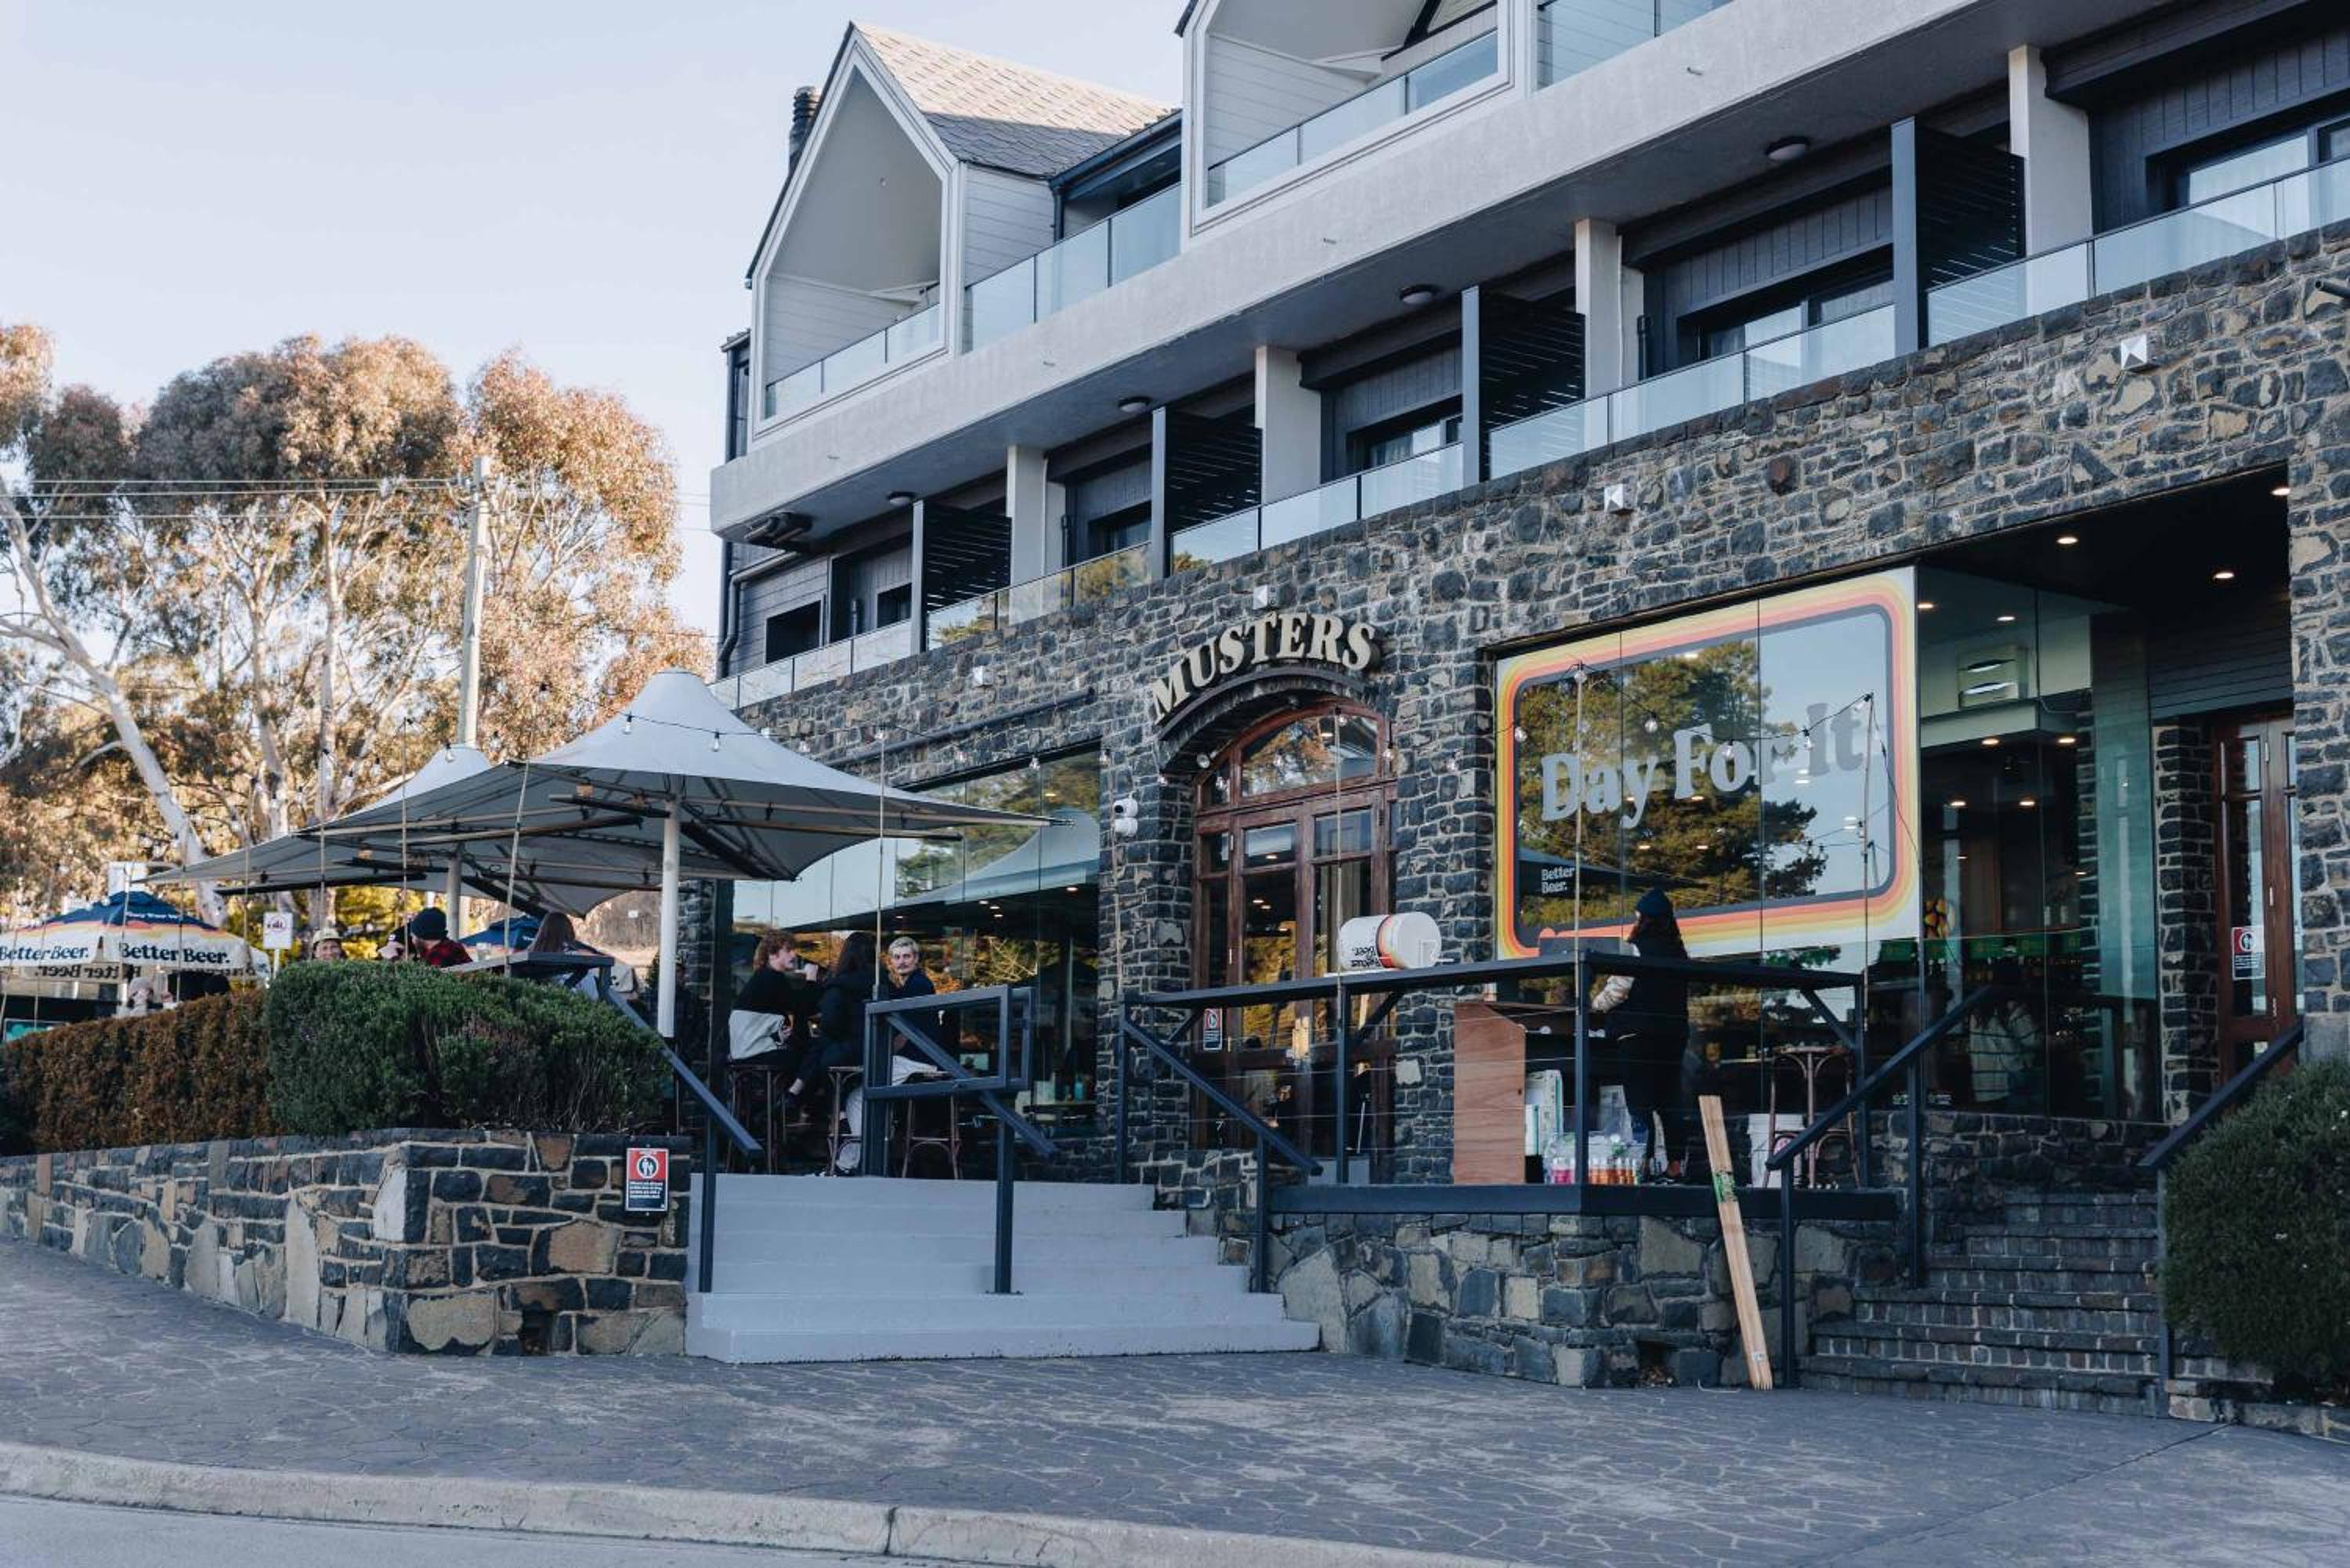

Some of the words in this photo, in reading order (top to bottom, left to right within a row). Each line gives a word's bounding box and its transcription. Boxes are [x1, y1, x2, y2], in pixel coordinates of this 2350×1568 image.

[1151, 612, 1376, 724] MUSTERS
[1542, 753, 1658, 829] Day
[1673, 724, 1796, 799] For
[1806, 703, 1864, 776] It
[1542, 866, 1575, 880] Better
[0, 946, 50, 960] Better
[50, 945, 89, 959] Beer.
[119, 942, 179, 961] Better
[183, 948, 230, 963] Beer.
